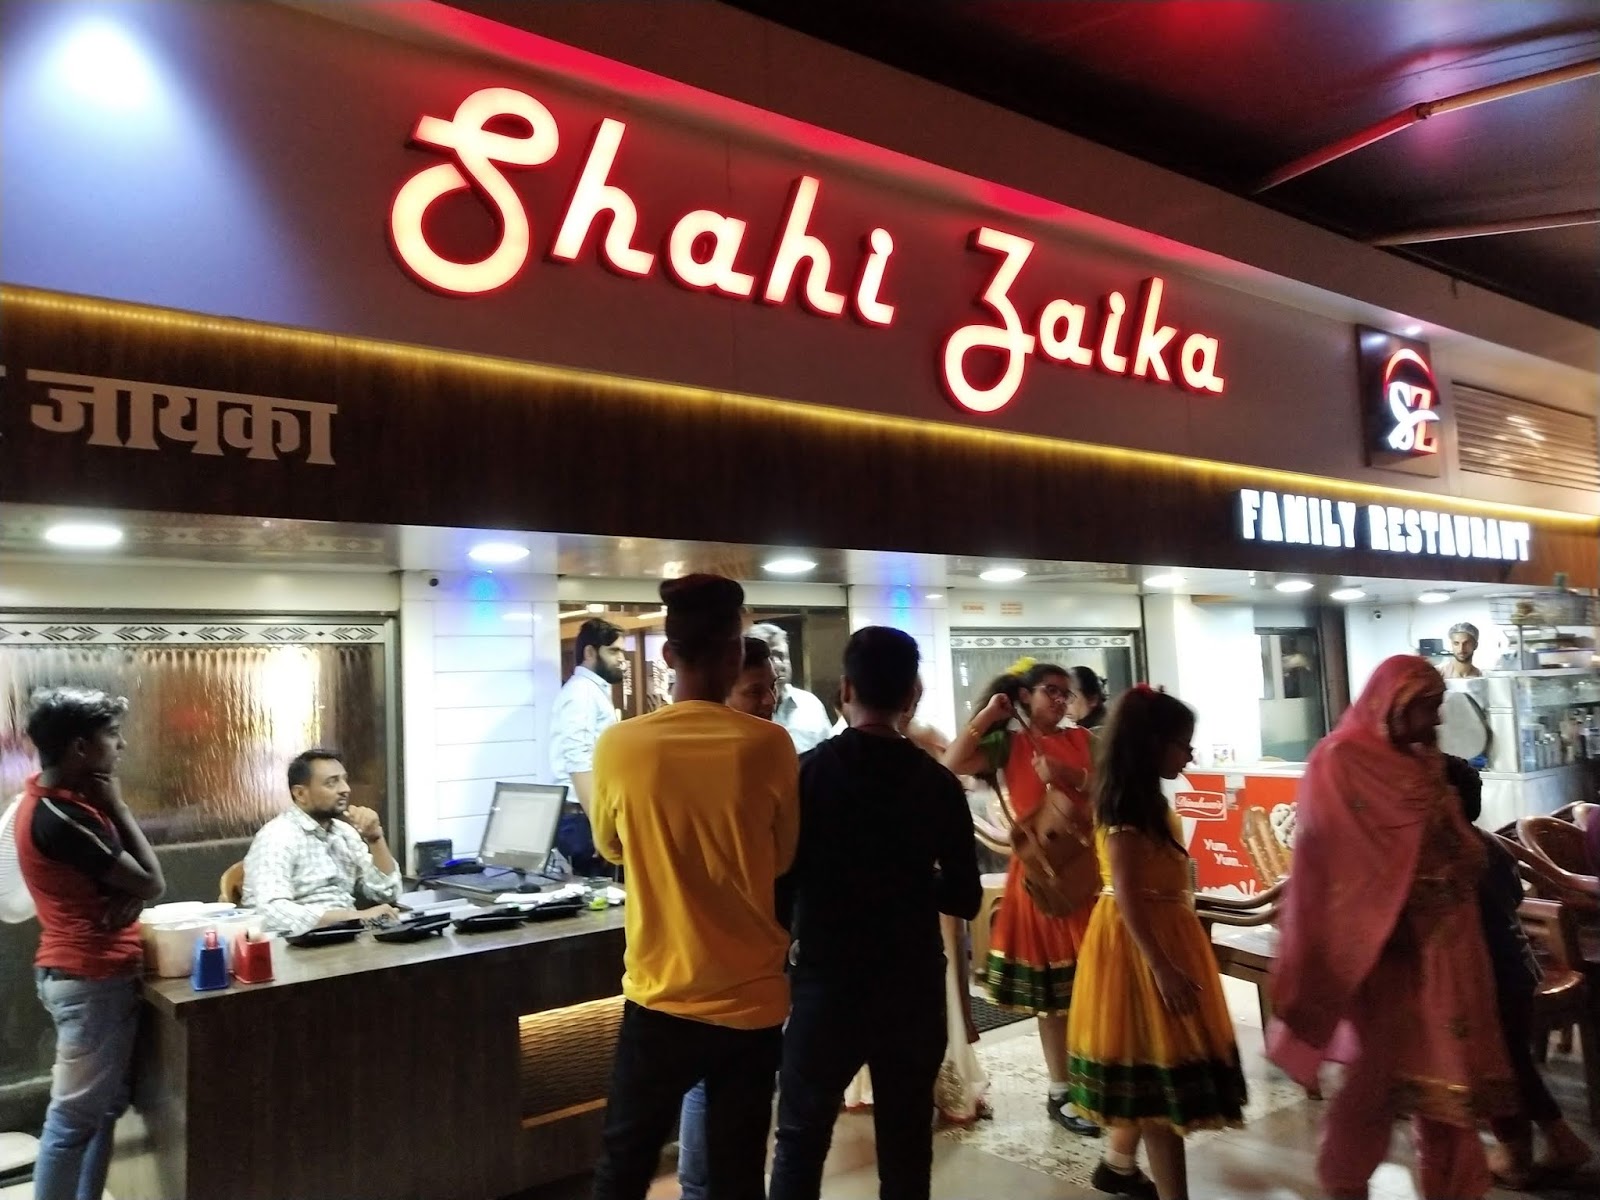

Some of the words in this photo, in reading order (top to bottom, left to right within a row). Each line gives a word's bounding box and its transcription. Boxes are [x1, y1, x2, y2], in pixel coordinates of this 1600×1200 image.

[390, 86, 896, 326] Shahi
[943, 226, 1225, 414] Zaika
[26, 368, 338, 466] जायका
[1240, 488, 1357, 548] FAMILY
[1368, 504, 1530, 562] RESTAURANT
